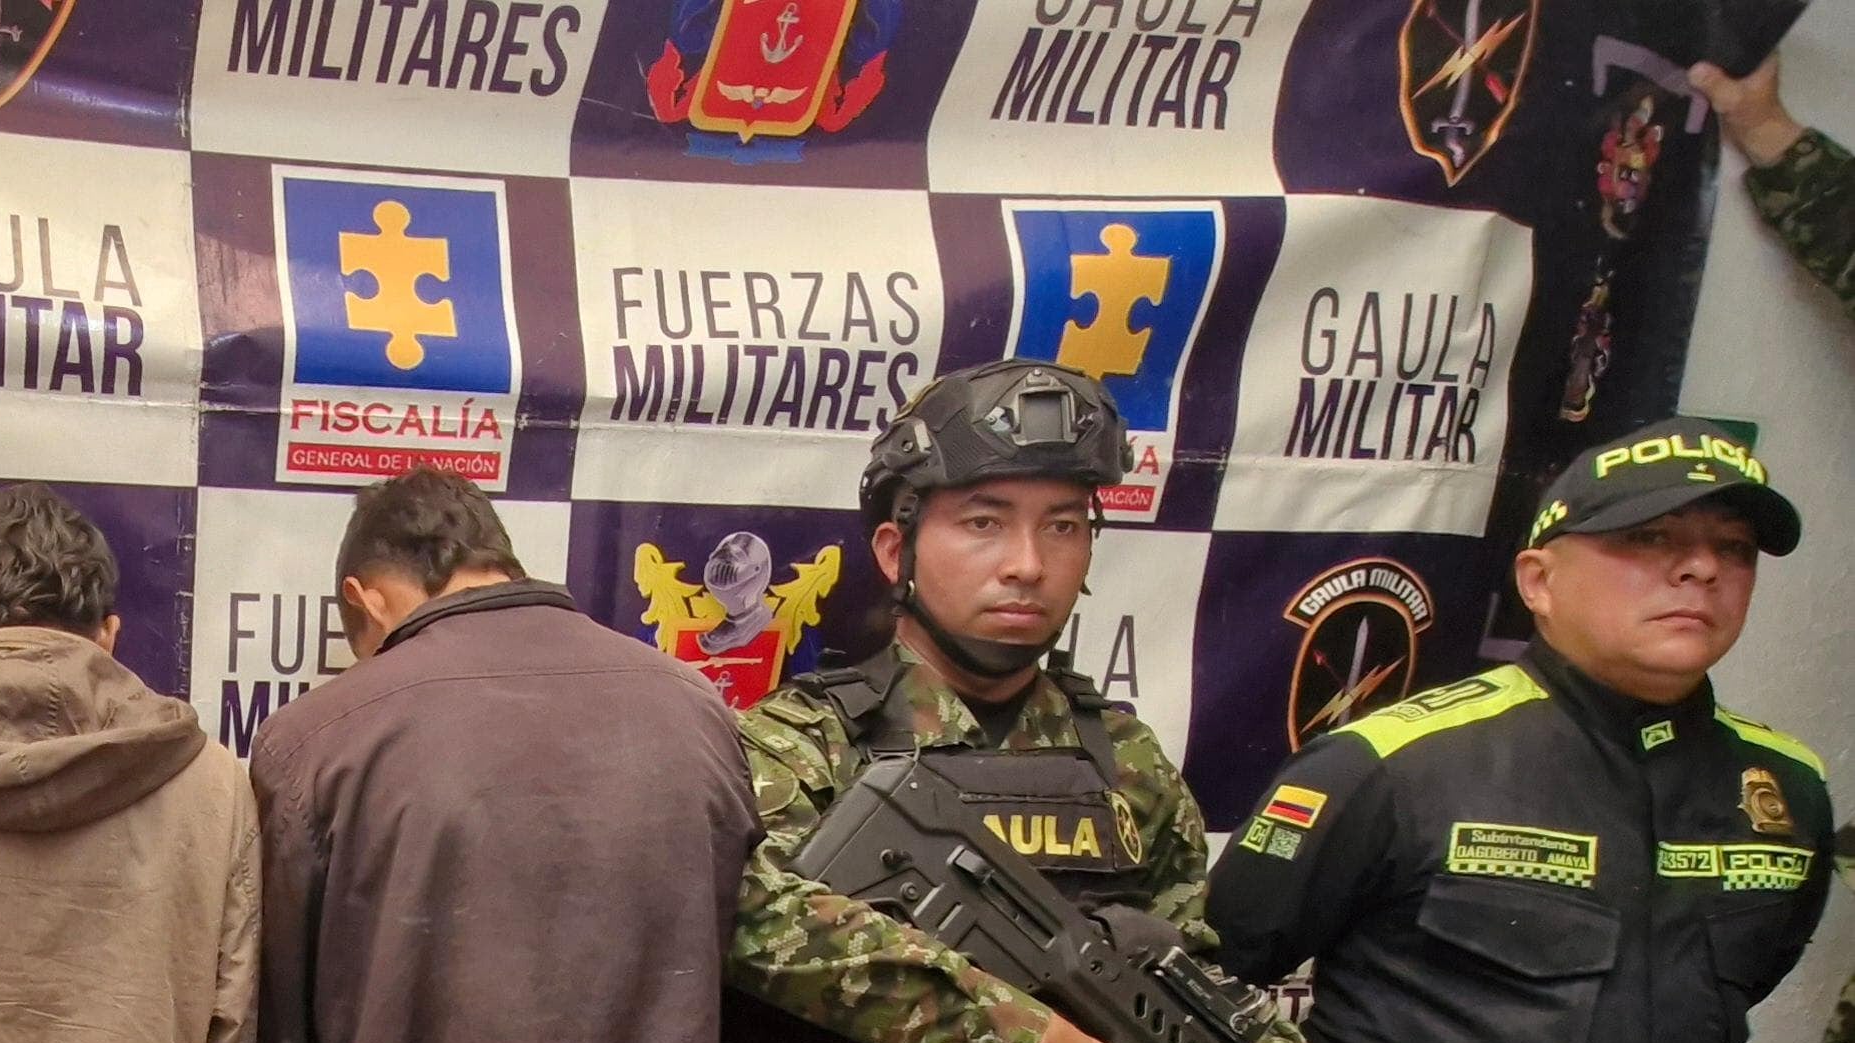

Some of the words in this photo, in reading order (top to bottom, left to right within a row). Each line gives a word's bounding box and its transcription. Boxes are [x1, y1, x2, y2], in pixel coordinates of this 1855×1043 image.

[226, 0, 581, 97] MILITARES
[990, 27, 1242, 130] MILITAR
[612, 266, 921, 346] FUERZAS
[1301, 287, 1496, 388] GAULA
[291, 398, 502, 440] FISCALÍA
[610, 345, 918, 432] MILITARES
[1284, 378, 1480, 464] MILITAR
[293, 451, 373, 469] GENERAL
[378, 454, 402, 470] DE
[432, 454, 496, 474] NACIÓN
[1299, 569, 1367, 616] GAULA
[1369, 568, 1428, 621] MILITAR
[1547, 852, 1589, 869] AMAYA
